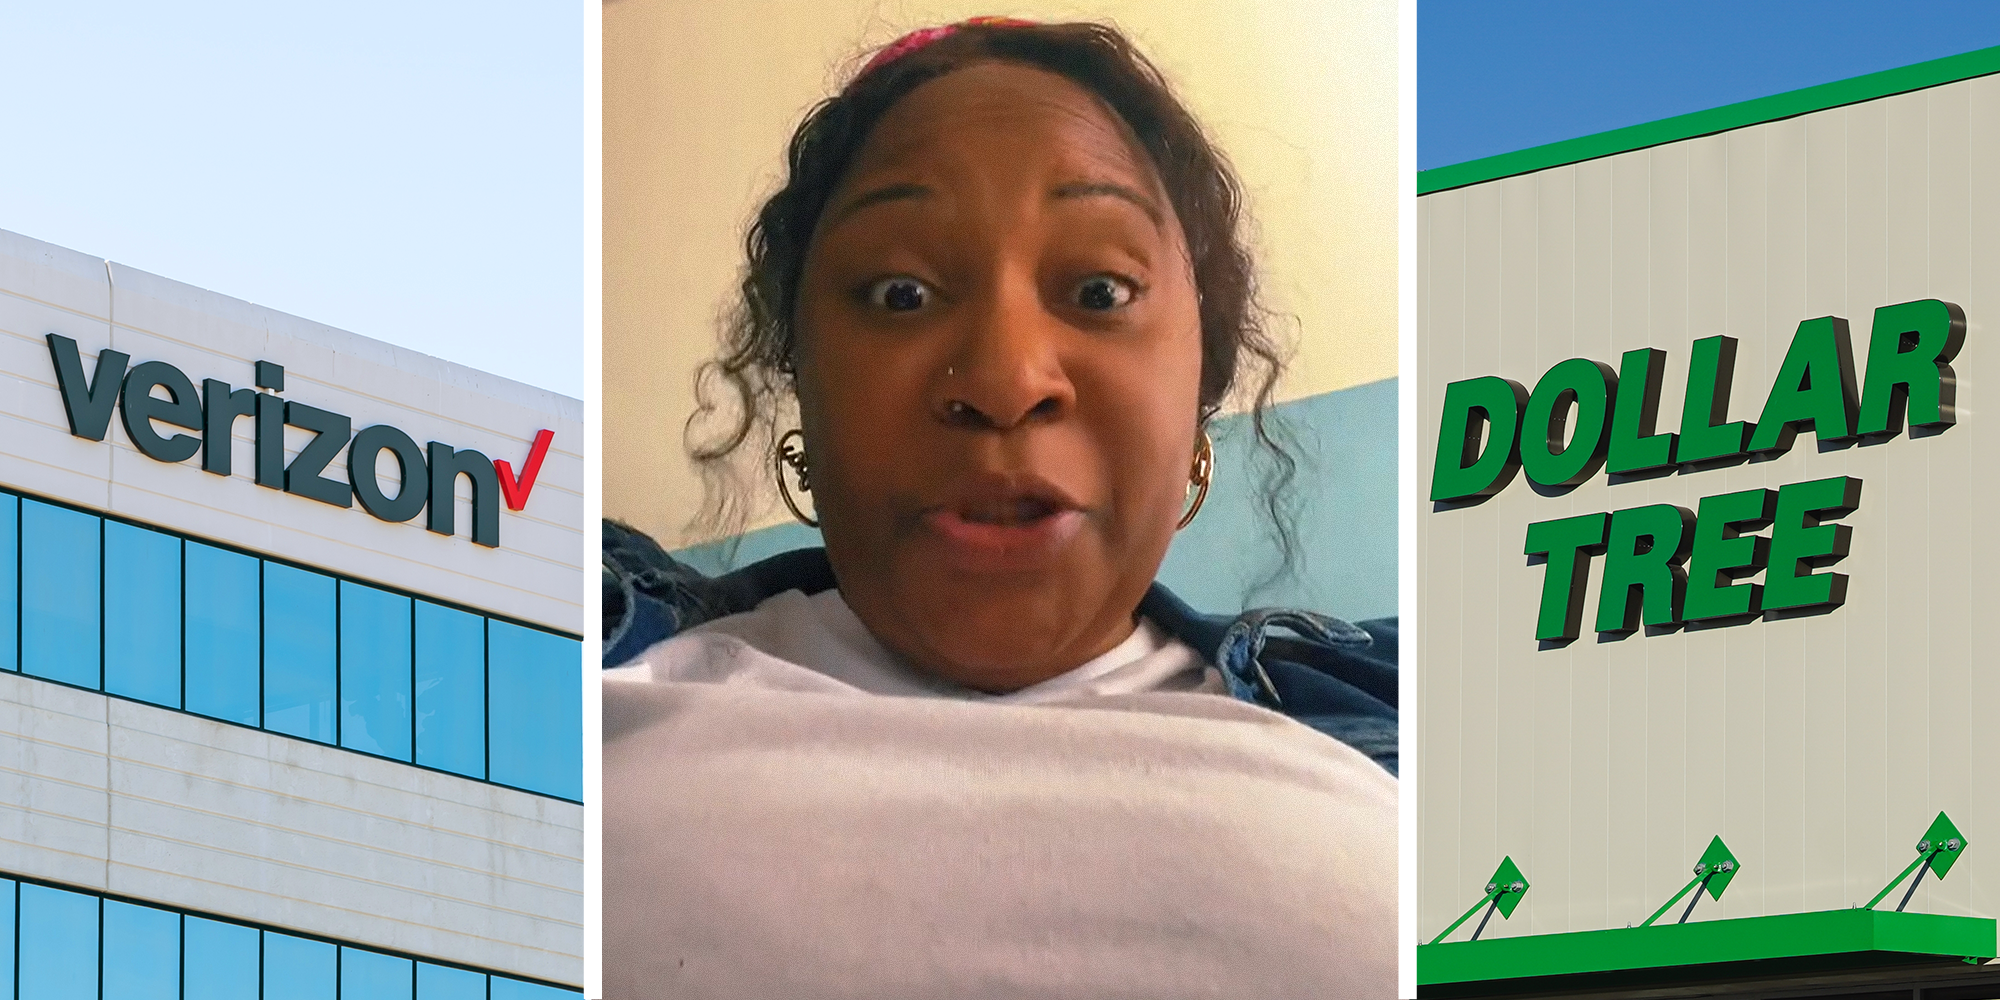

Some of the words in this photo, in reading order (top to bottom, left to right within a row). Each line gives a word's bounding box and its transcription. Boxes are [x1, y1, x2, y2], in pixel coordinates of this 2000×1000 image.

[46, 333, 500, 548] verizon
[1430, 298, 1967, 503] DOLLAR
[1524, 475, 1863, 643] TREE
